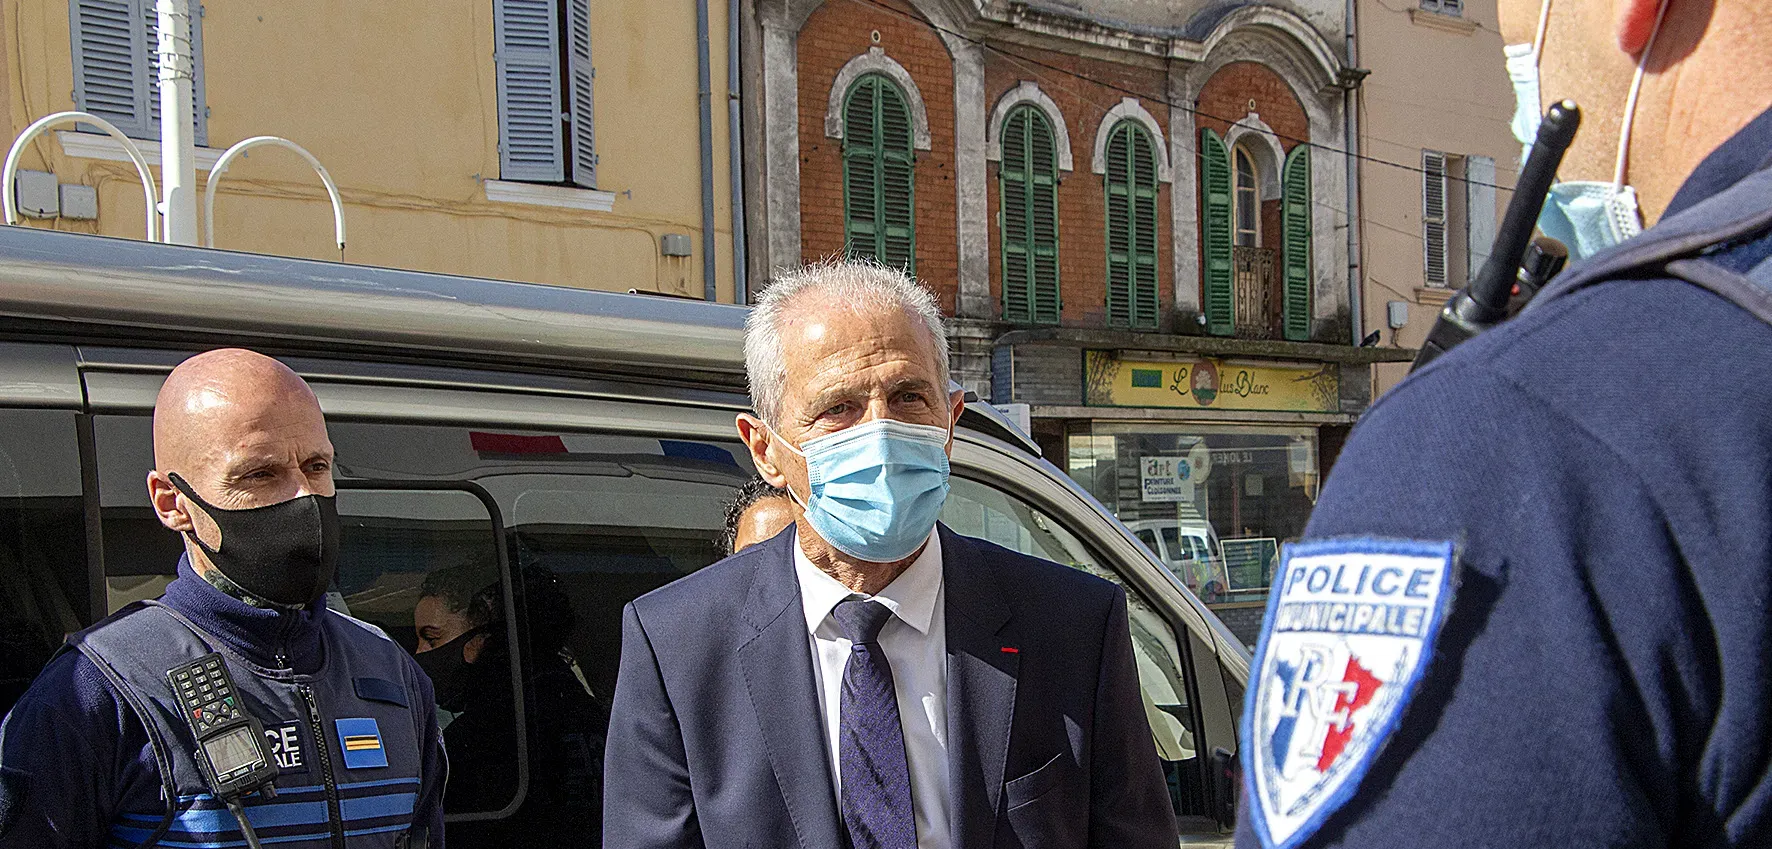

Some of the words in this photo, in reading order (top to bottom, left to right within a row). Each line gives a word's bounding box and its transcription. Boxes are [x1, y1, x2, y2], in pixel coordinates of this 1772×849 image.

[1235, 370, 1269, 397] Blanc
[1286, 565, 1435, 598] POLICE
[1277, 603, 1421, 635] MUNICIPALE
[264, 726, 299, 753] CE
[274, 752, 302, 767] ALE
